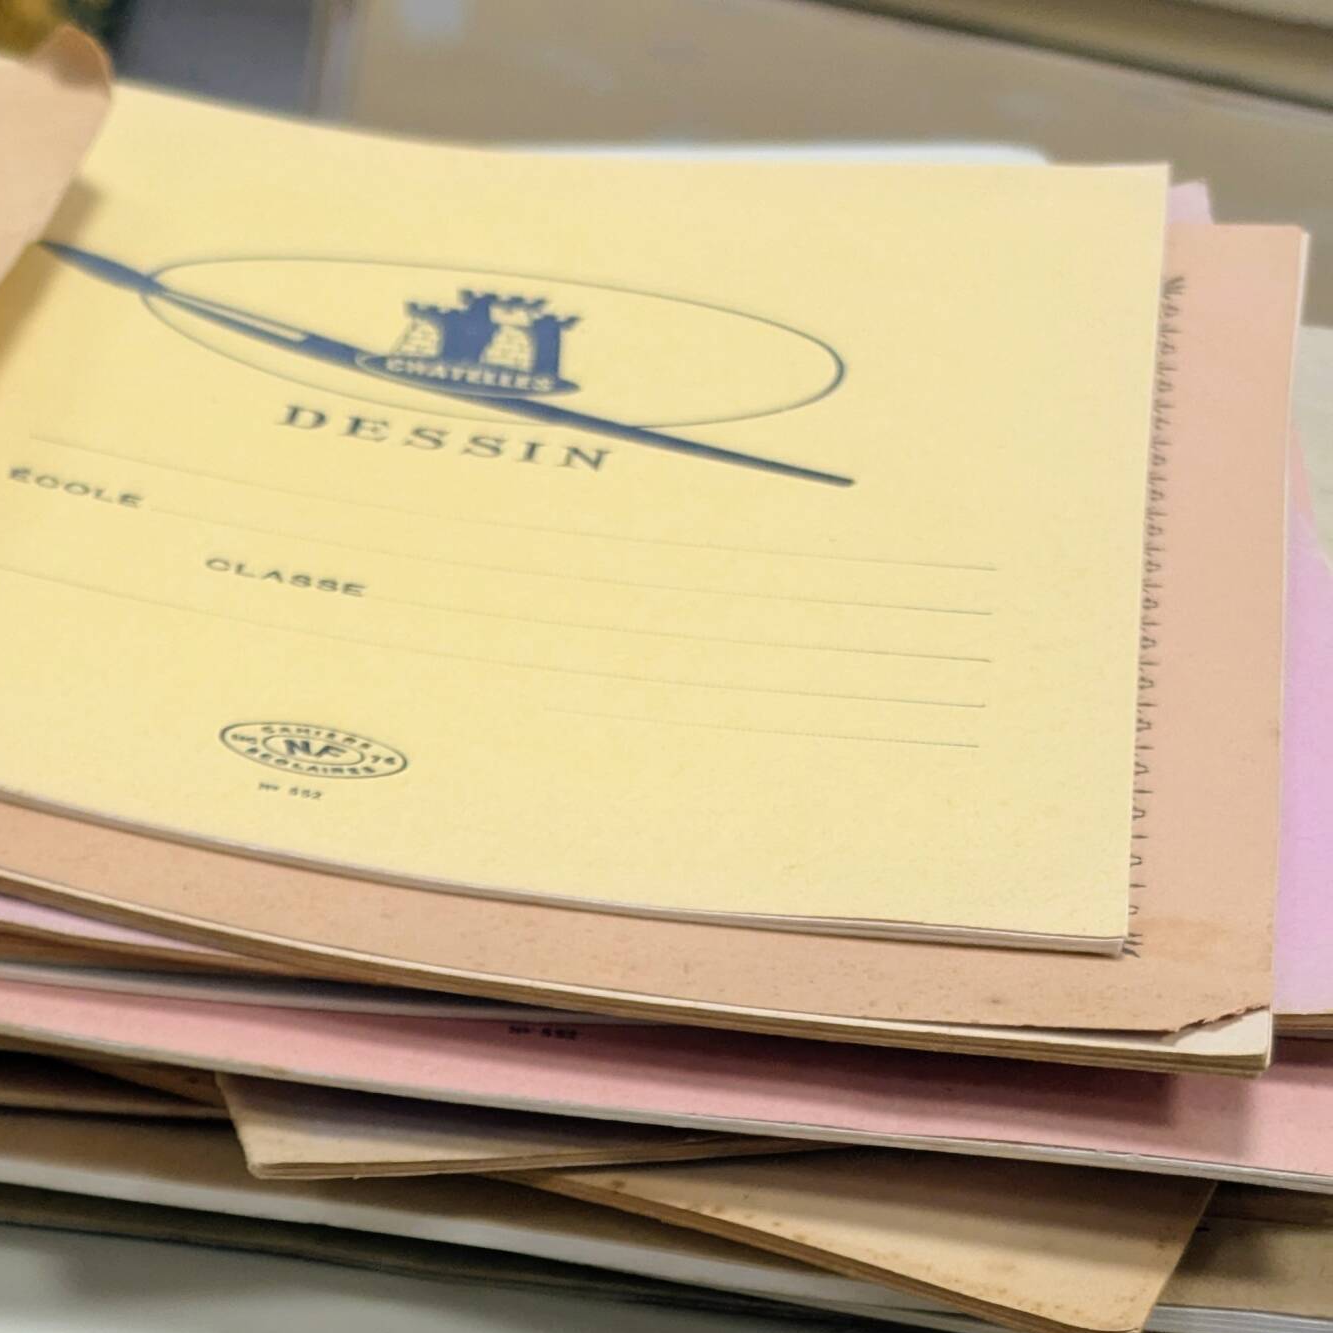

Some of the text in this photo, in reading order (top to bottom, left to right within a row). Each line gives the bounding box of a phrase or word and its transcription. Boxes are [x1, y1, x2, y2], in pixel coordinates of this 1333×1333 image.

[275, 404, 613, 472] DESSIN
[6, 462, 146, 509] ÉCOLE
[204, 556, 370, 598] CLASSE
[284, 738, 347, 758] NF
